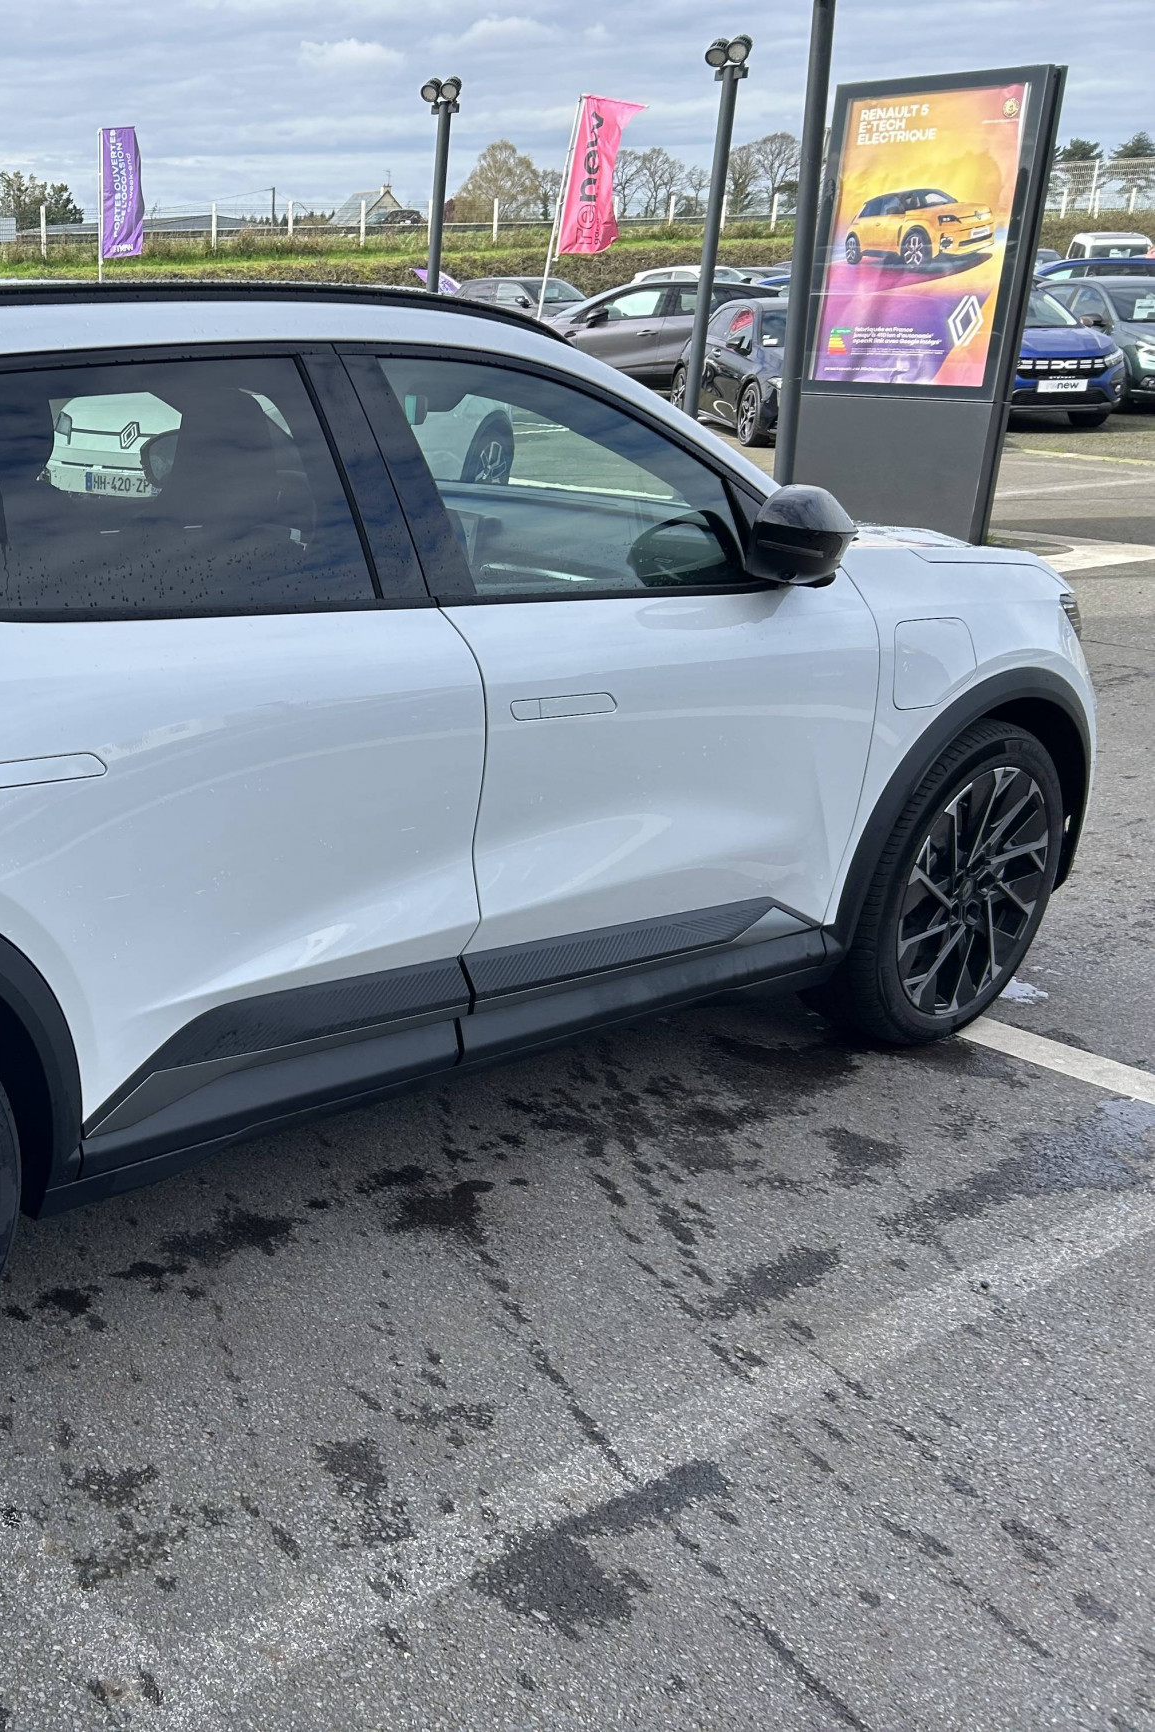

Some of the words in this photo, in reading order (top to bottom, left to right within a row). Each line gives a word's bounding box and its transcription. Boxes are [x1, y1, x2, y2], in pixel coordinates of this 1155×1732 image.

[859, 119, 906, 133] E-TECH
[861, 104, 919, 121] RENAULT
[920, 104, 930, 116] 5
[857, 128, 936, 145] ELECTRIQUE
[109, 129, 121, 192] OUVERTES
[116, 142, 128, 208] L'OCCASION
[125, 153, 134, 199] week-end
[575, 111, 604, 245] renew
[113, 193, 122, 238] PORTES
[93, 476, 150, 493] HH-420-ZP
